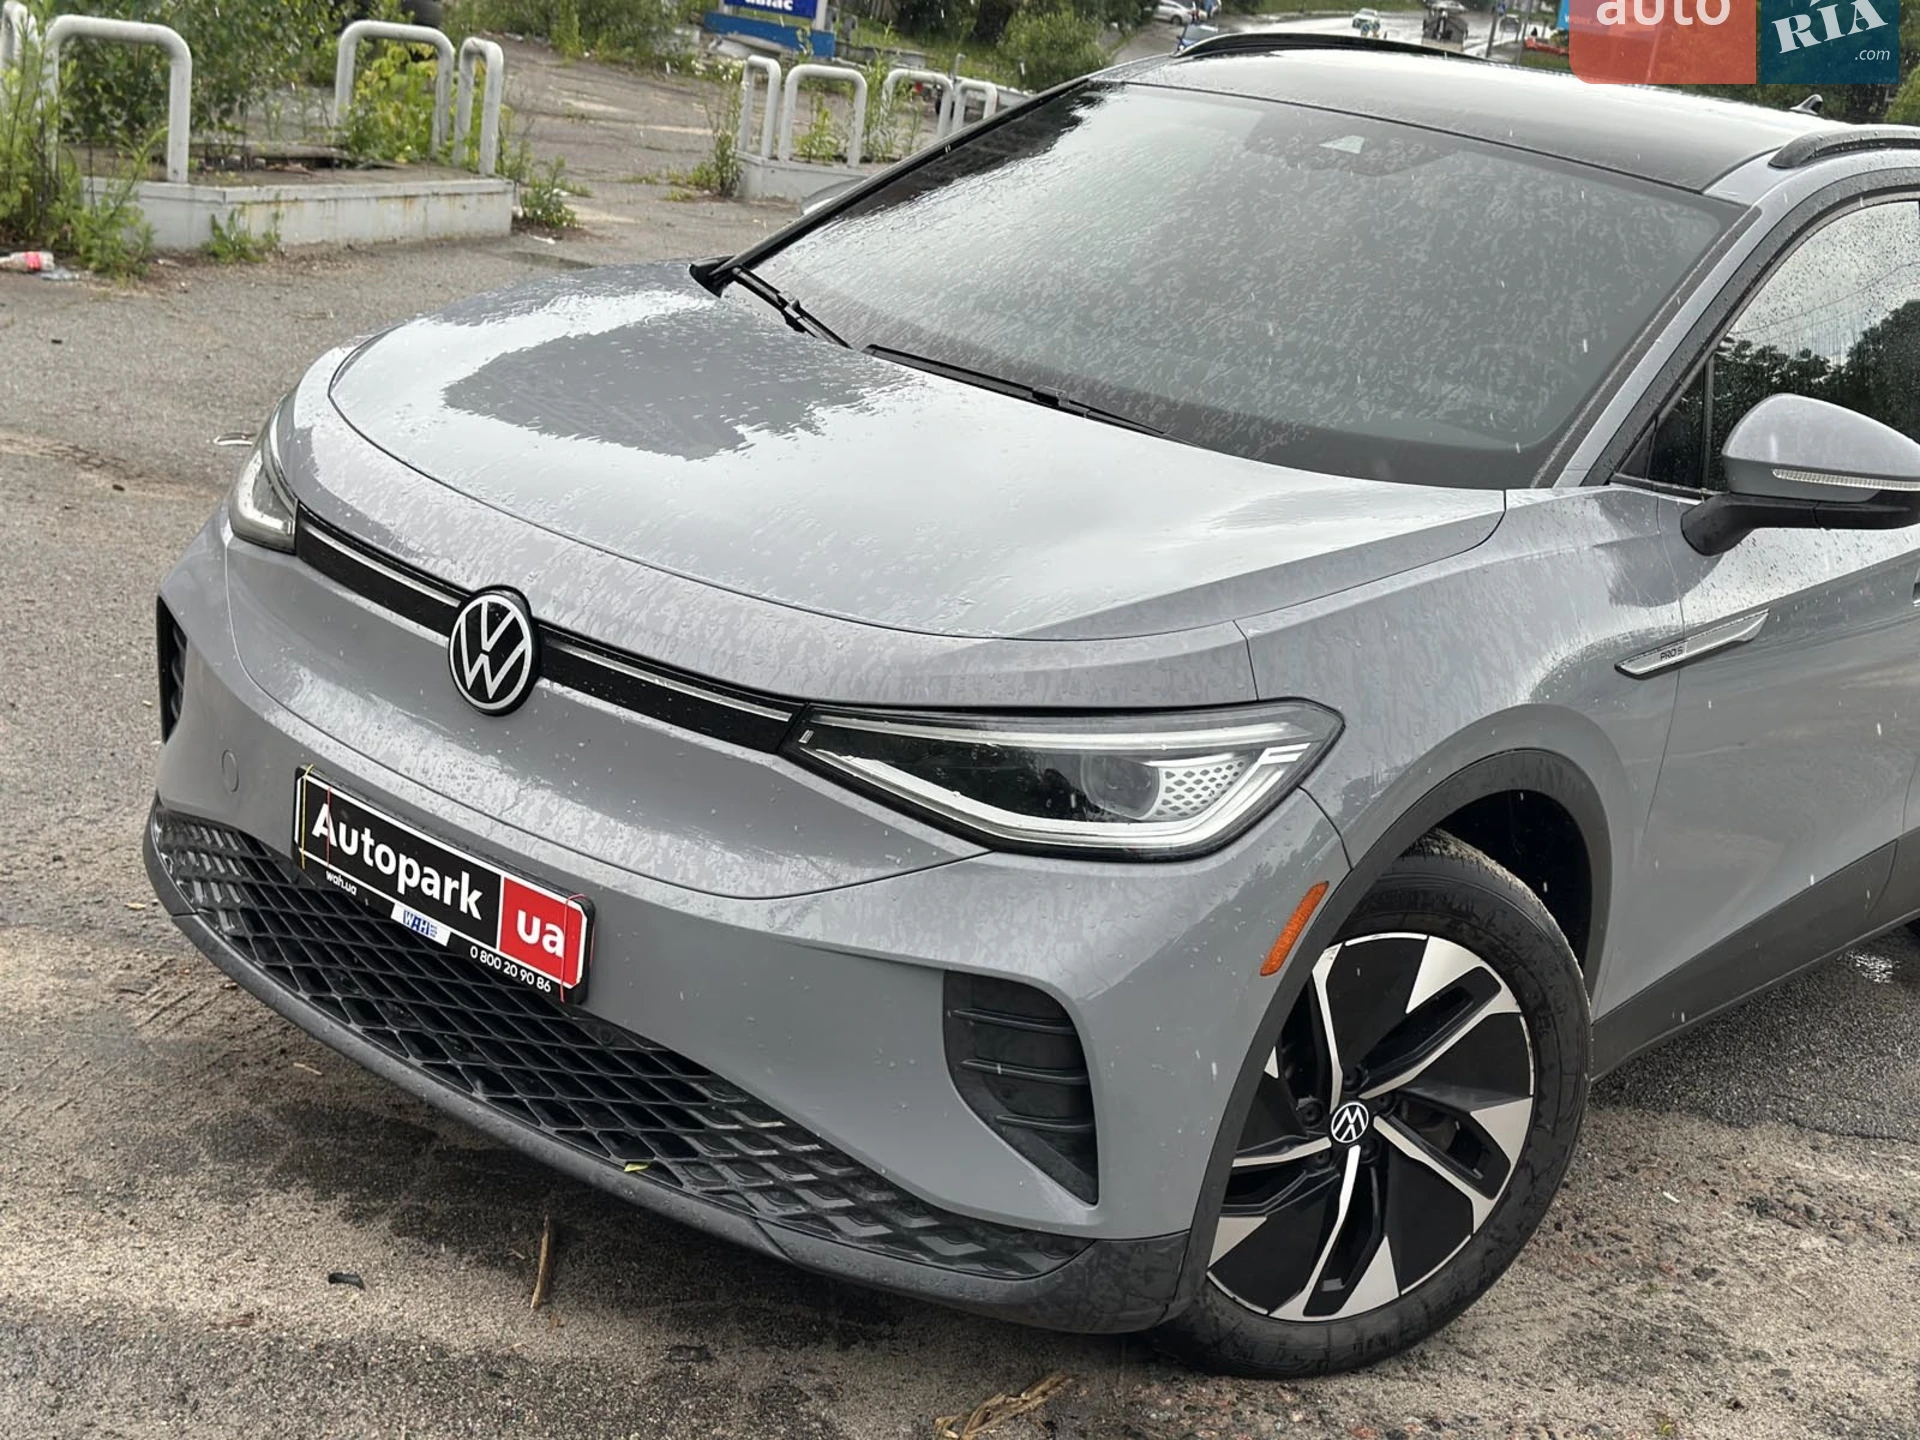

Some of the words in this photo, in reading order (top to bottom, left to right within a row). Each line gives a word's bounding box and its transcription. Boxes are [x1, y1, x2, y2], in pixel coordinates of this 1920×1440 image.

[311, 803, 483, 921] Autopark
[516, 909, 565, 959] ua
[469, 945, 479, 959] 0
[480, 950, 501, 970] 800
[503, 961, 518, 978] 20
[520, 969, 534, 985] 90
[536, 976, 551, 993] 86
